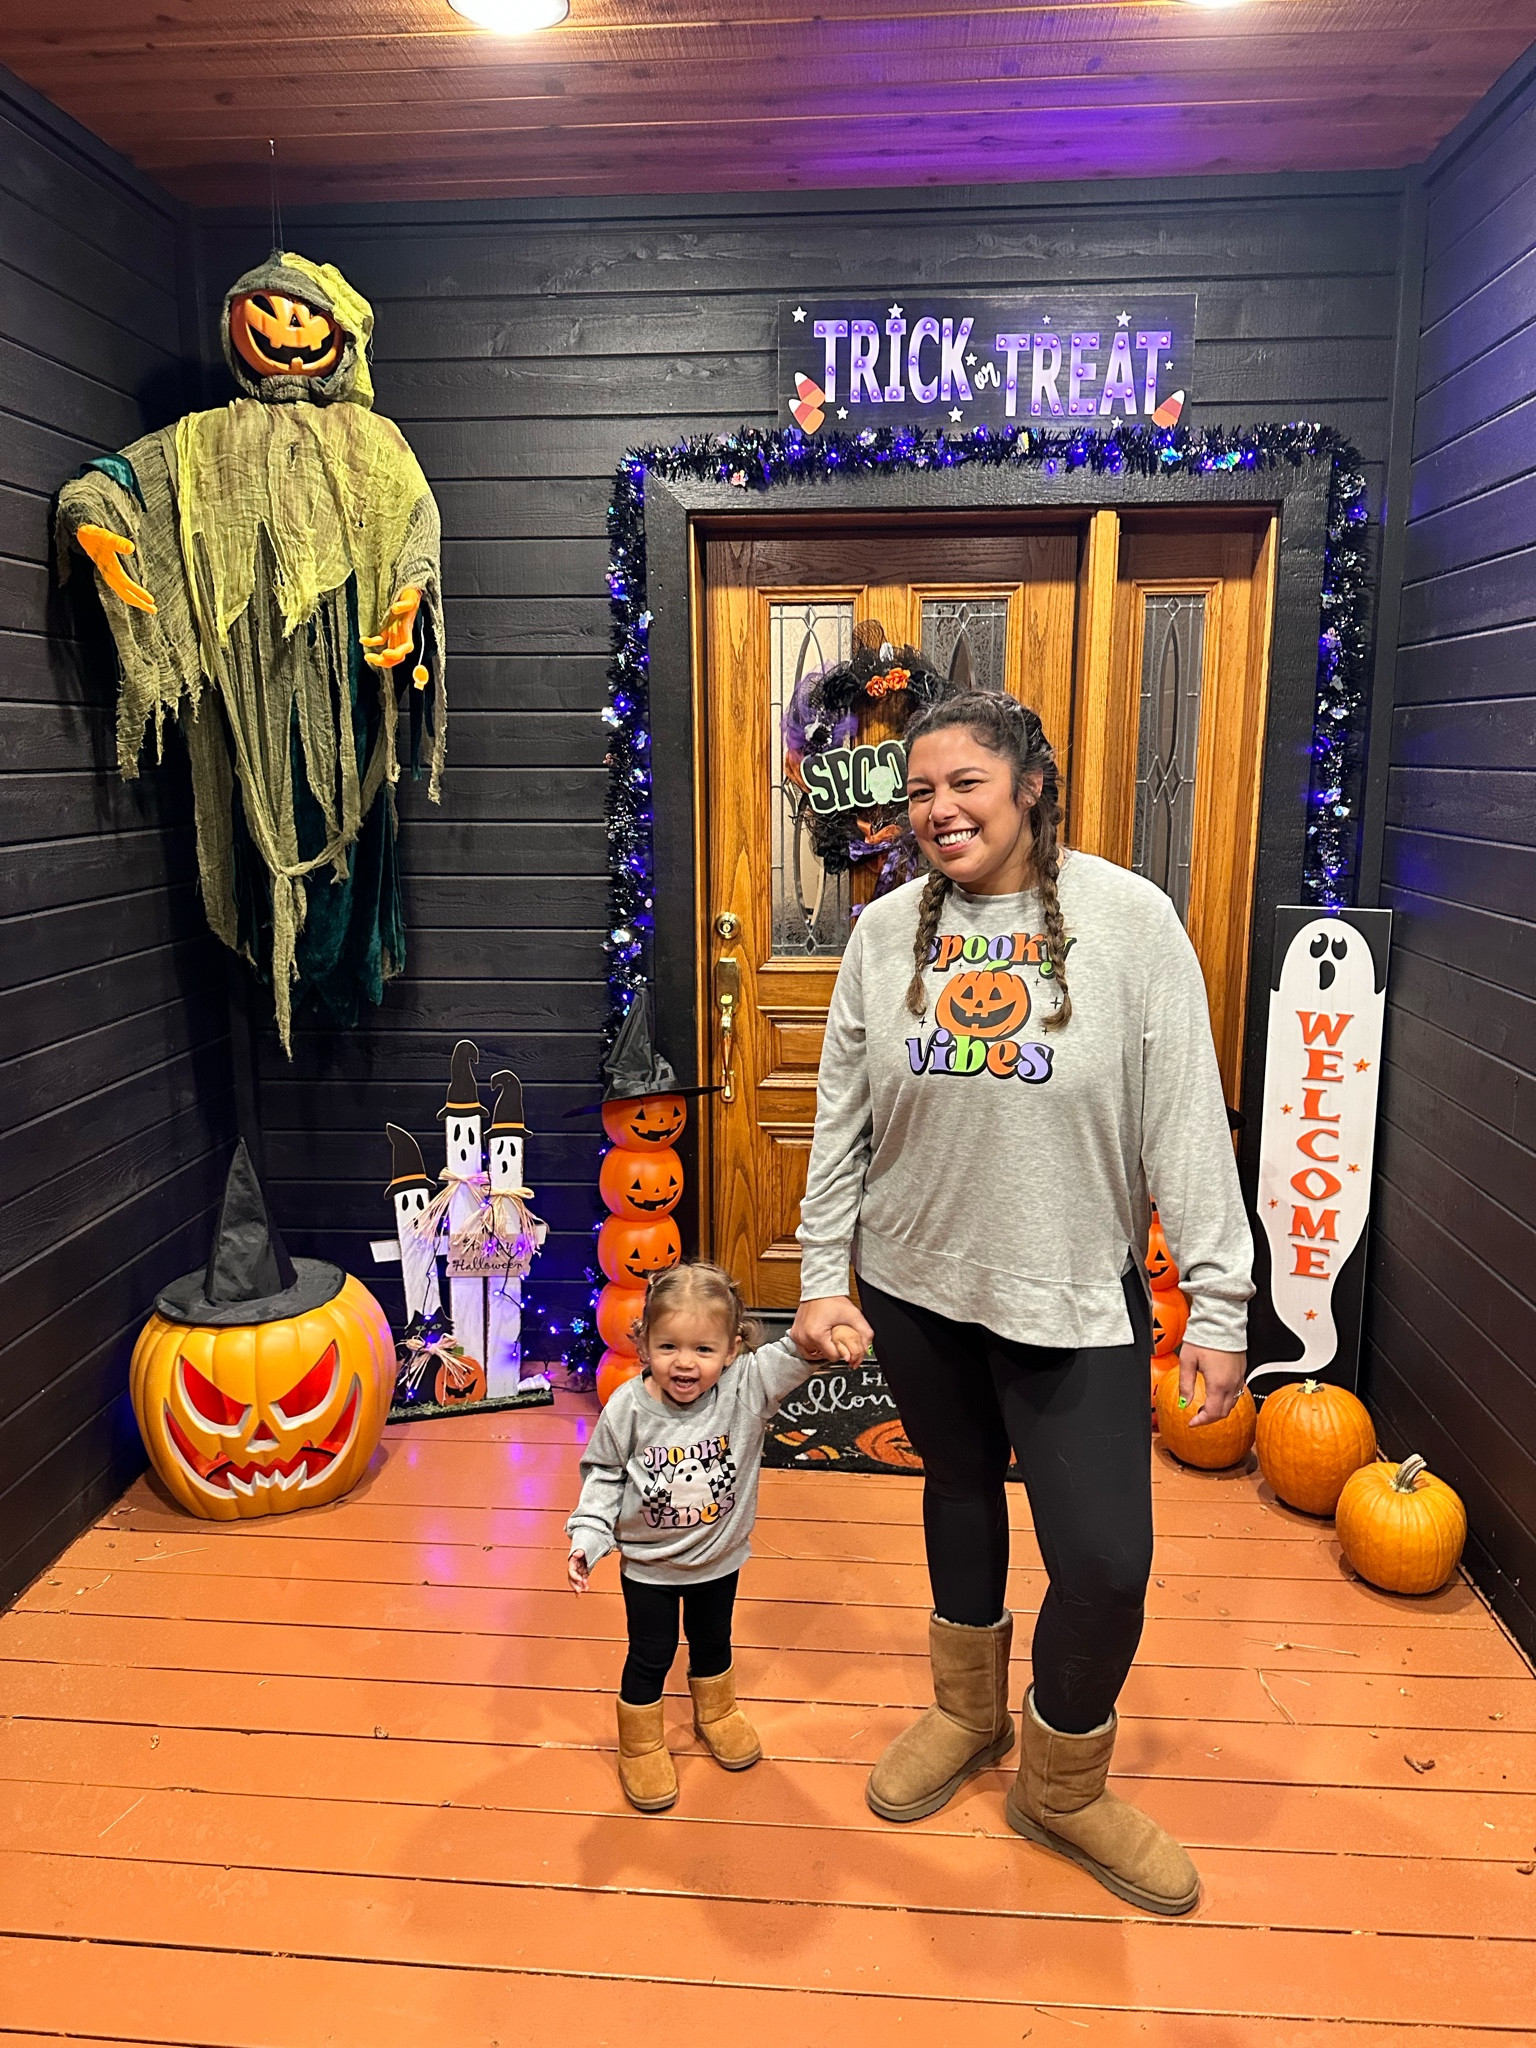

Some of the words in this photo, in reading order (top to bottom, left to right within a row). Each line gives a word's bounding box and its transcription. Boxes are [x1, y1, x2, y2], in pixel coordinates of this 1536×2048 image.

[813, 317, 974, 403] TRICK
[974, 361, 1000, 390] or
[995, 331, 1172, 417] TREAT
[800, 740, 909, 814] SPOO
[905, 1027, 1054, 1084] vibes
[1288, 1010, 1355, 1280] WELCOME
[452, 1257, 523, 1272] Halloween
